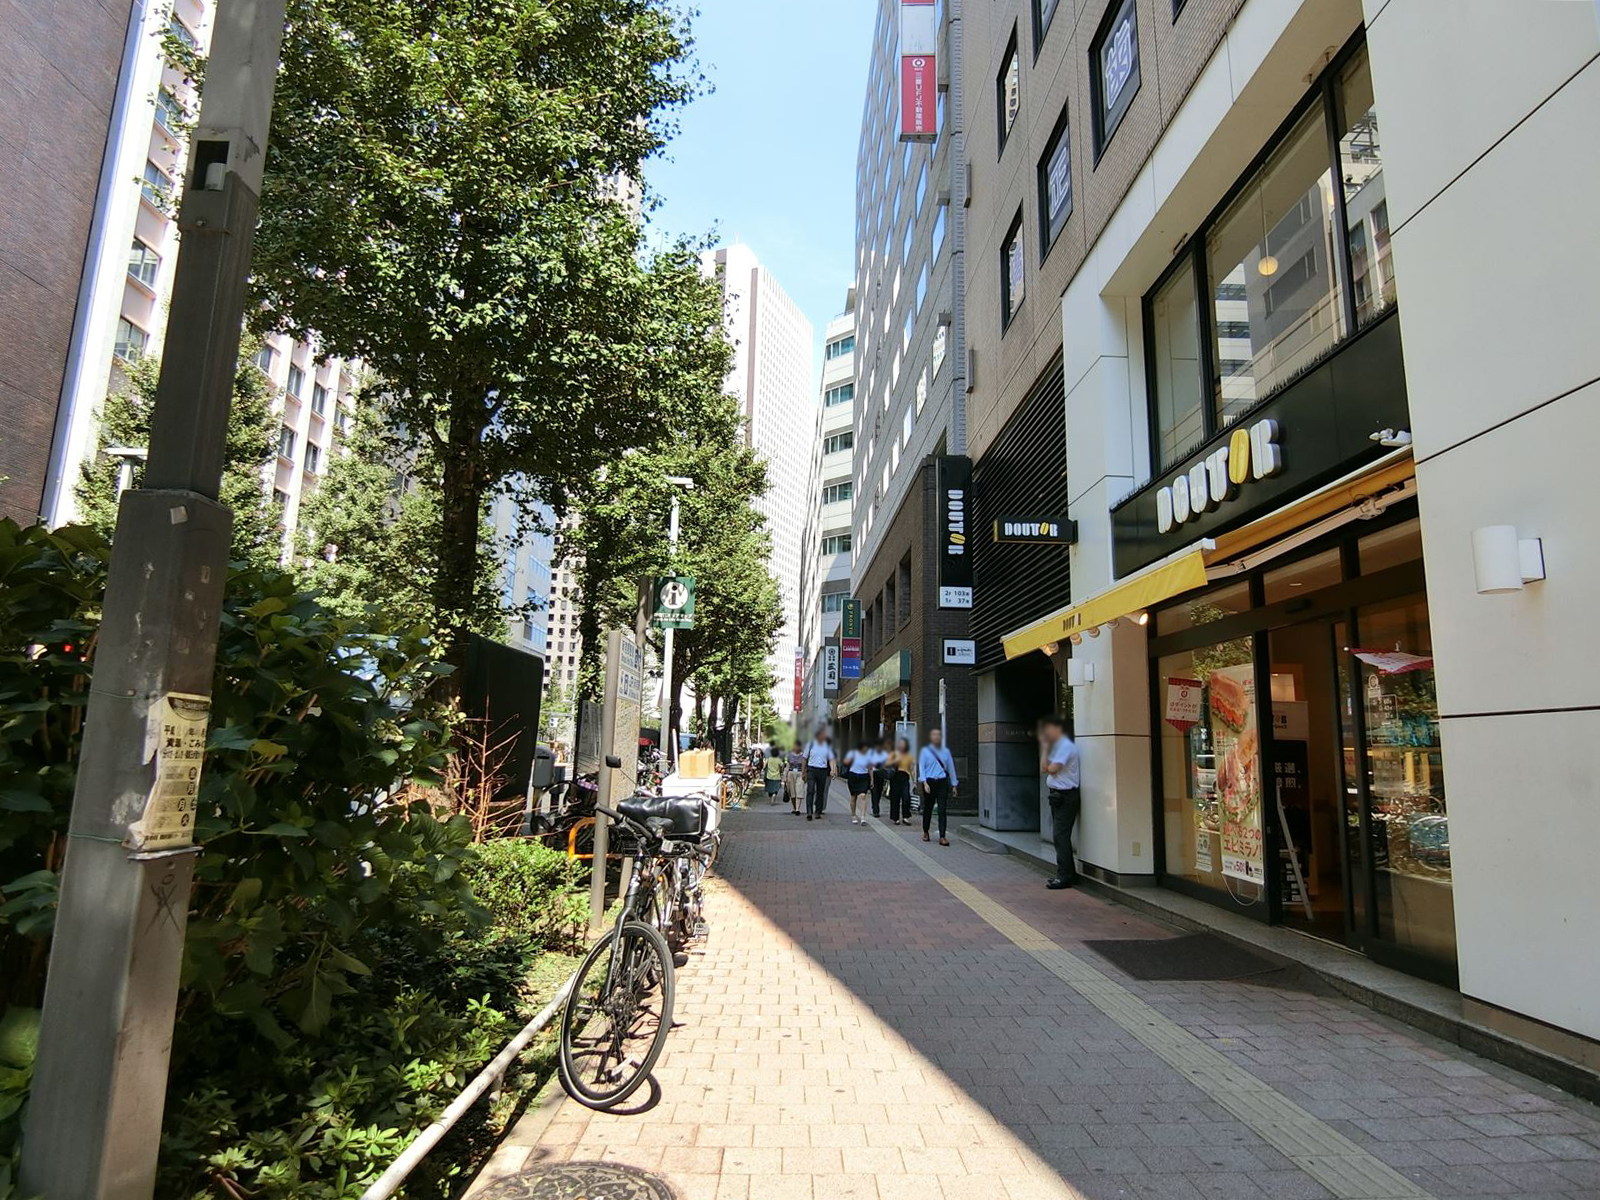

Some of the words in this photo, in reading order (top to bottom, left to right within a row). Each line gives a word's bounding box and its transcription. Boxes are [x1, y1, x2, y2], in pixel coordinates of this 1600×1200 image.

[1156, 418, 1282, 534] DOUTOR
[948, 489, 966, 555] DOUTOR
[1004, 521, 1059, 537] DOUTOR
